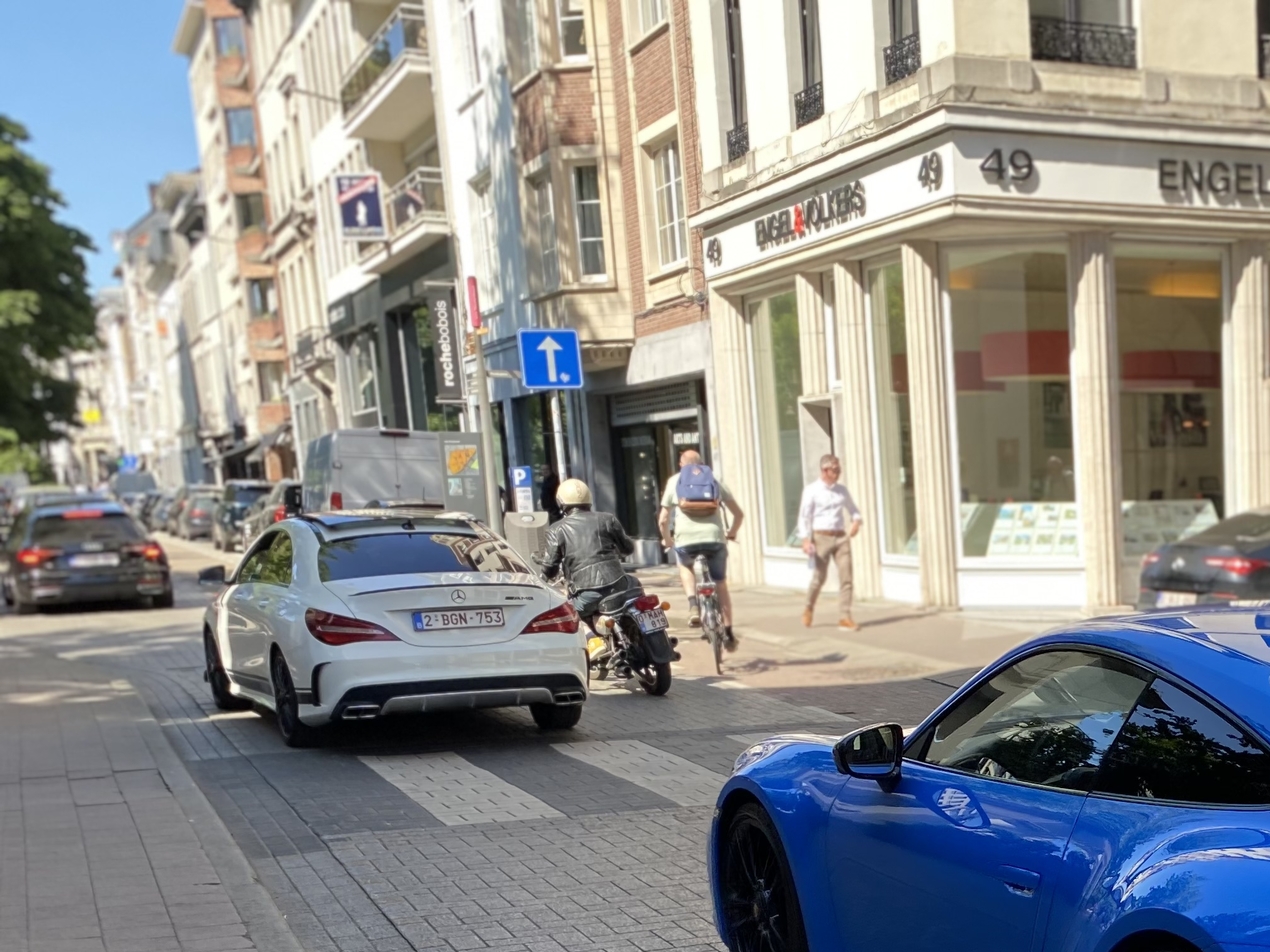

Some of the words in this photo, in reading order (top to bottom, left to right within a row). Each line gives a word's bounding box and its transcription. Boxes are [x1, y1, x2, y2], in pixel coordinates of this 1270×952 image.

[918, 151, 942, 190] 49
[980, 148, 1033, 182] 49
[706, 237, 722, 265] 49
[434, 300, 455, 387] rochebobois
[513, 468, 527, 486] P
